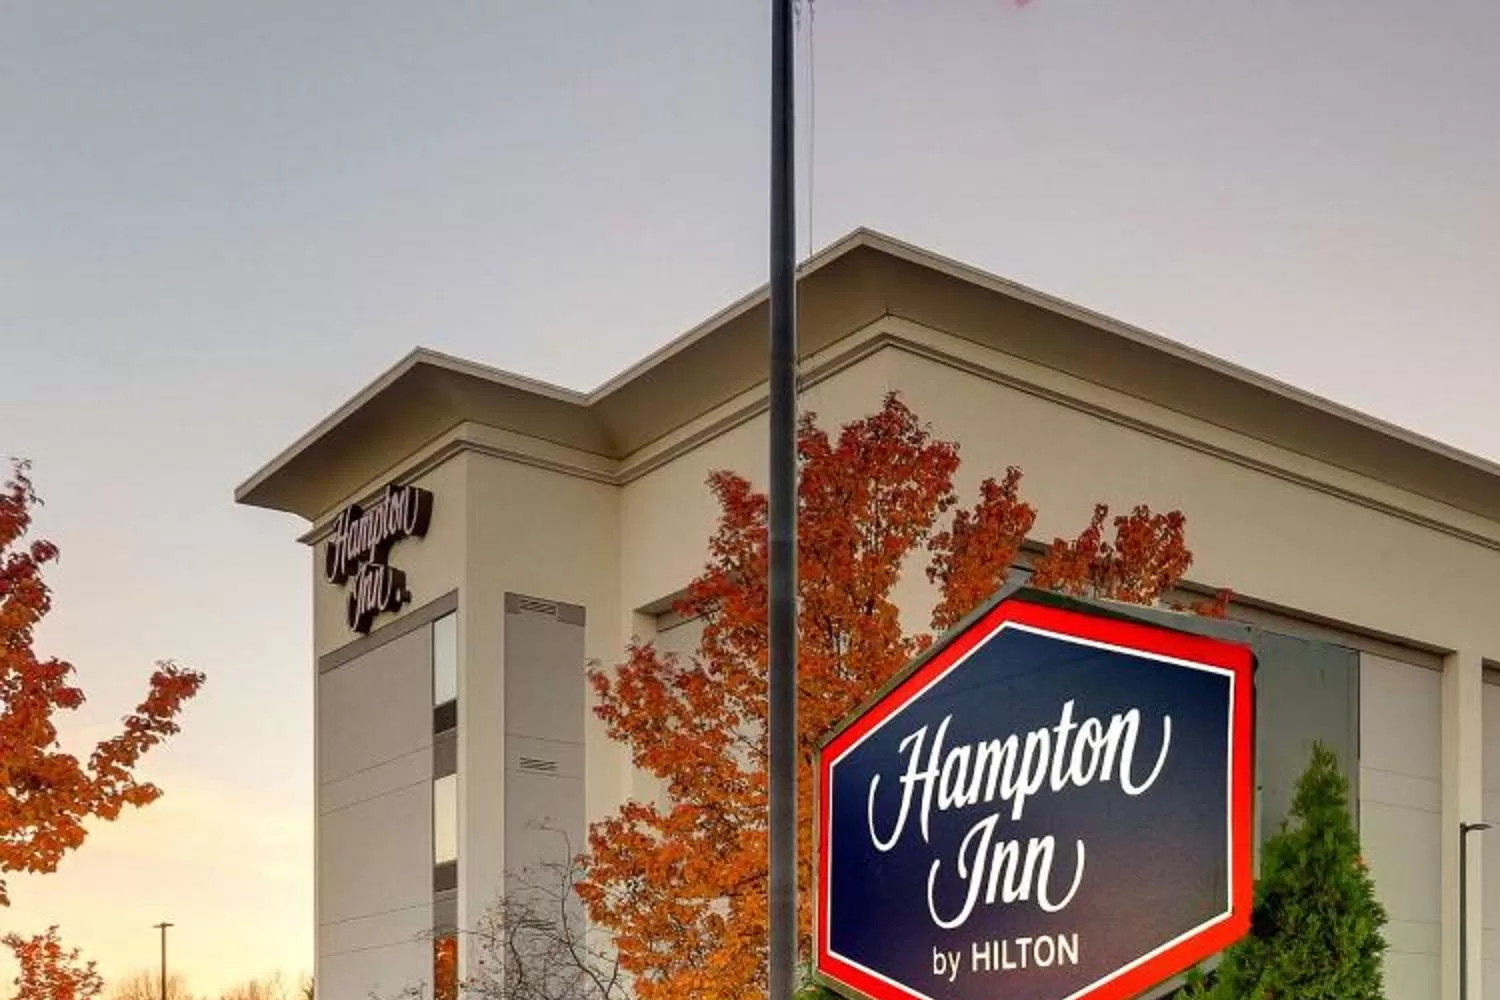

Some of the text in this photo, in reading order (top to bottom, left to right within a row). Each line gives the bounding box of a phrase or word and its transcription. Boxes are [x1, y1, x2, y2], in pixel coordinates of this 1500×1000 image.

[325, 484, 430, 584] Hampton
[349, 563, 402, 633] Inn
[867, 699, 1172, 851] Hampton
[927, 813, 1085, 930] Inn
[933, 933, 1080, 983] by HILTON
